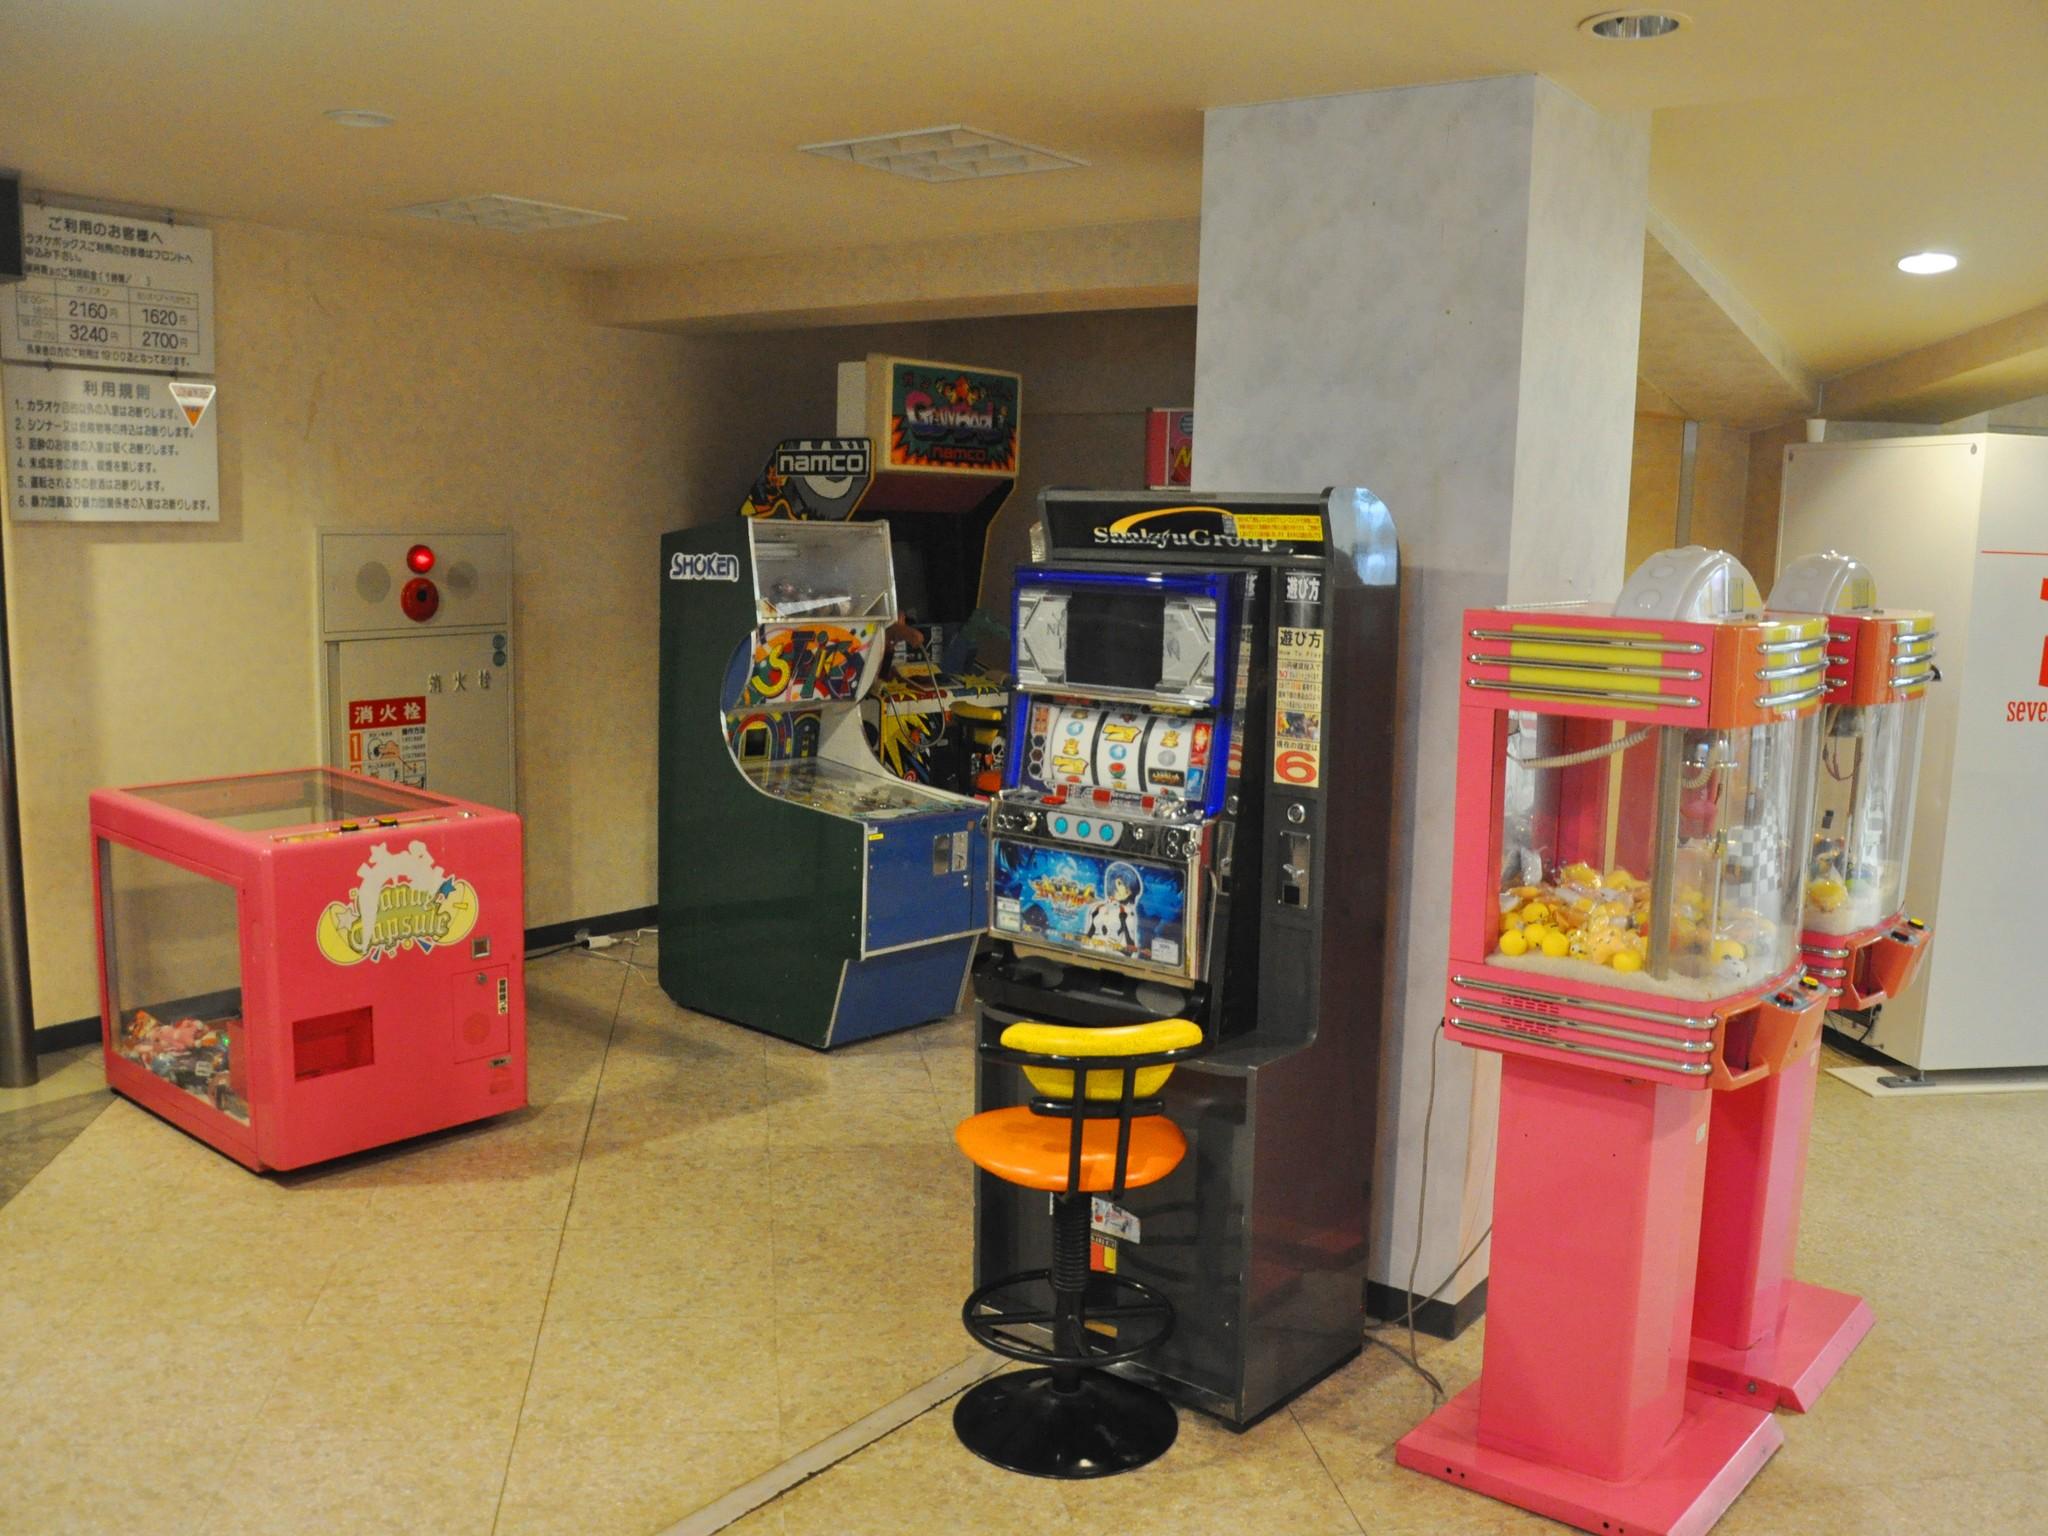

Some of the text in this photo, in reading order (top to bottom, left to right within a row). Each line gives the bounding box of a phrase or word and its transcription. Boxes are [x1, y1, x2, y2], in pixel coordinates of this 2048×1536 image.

[48, 216, 163, 244] ご利用のお客様へ
[83, 380, 150, 400] 利用規則
[778, 453, 864, 474] namco
[671, 553, 739, 581] SHOKEN
[1286, 576, 1321, 601] 遊び方
[1280, 629, 1322, 649] 遊び方
[427, 669, 493, 694] 消火栓
[354, 702, 422, 725] 消火栓
[1276, 751, 1317, 783] 6
